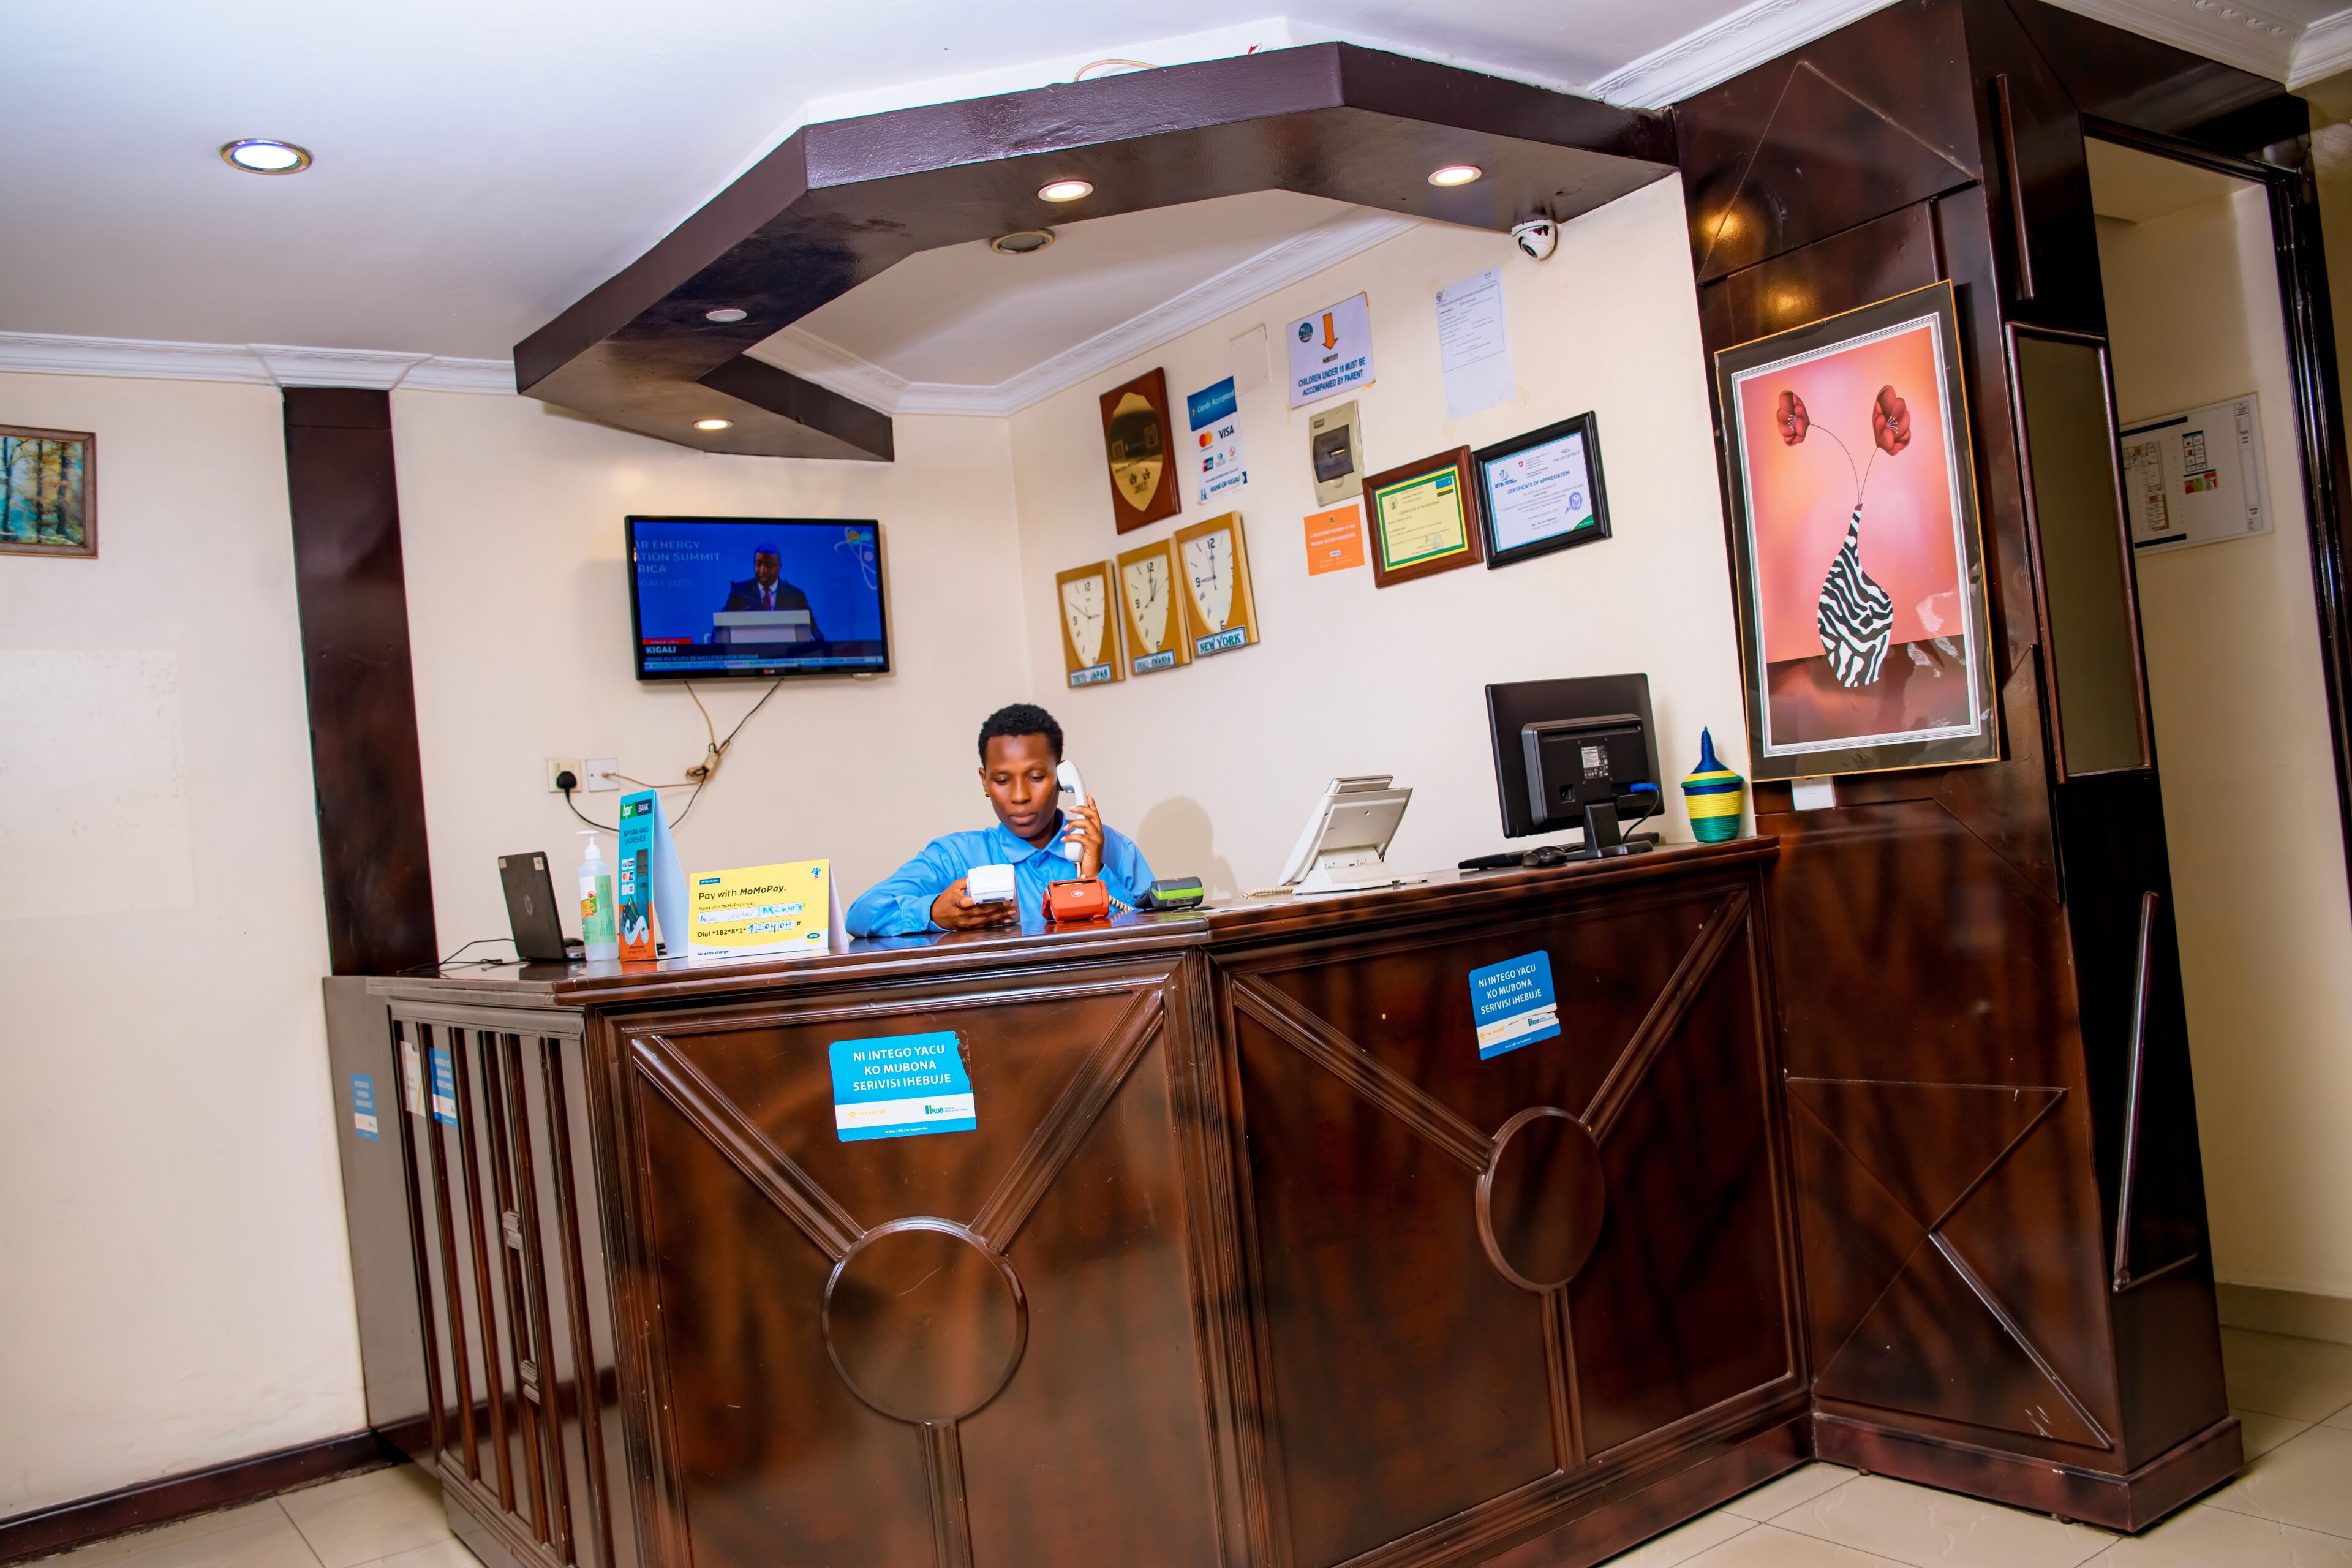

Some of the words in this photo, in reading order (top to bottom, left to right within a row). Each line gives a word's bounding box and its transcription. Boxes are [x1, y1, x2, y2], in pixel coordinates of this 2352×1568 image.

[1298, 373, 1321, 387] CHILDREN
[1322, 367, 1338, 379] UNDER
[1339, 364, 1344, 373] 18
[1345, 360, 1358, 371] MUST
[1359, 356, 1365, 366] BE
[1303, 379, 1336, 396] ACCOMPANIED
[1337, 376, 1344, 385] BY
[1344, 369, 1363, 383] PARENT
[1197, 402, 1211, 413] Cards
[1212, 389, 1234, 405] Accepted
[1218, 424, 1234, 439] VISA
[1210, 483, 1222, 492] BANK
[1507, 482, 1532, 494] CERTIFICATE
[1540, 470, 1570, 484] APPRECIATION
[653, 540, 700, 549] ENERGY
[1207, 538, 1216, 549] 12
[673, 552, 721, 561] SUMMIT
[1147, 562, 1154, 572] 12
[1084, 582, 1091, 592] 12
[1195, 577, 1201, 587] 9
[1135, 599, 1140, 609] 9
[1073, 616, 1078, 625] 9
[1200, 637, 1215, 655] NEW
[1216, 633, 1241, 650] YORK
[623, 805, 632, 819] bpr
[638, 803, 649, 813] BANK
[718, 889, 737, 898] with
[739, 885, 786, 896] MoMoPay.
[1479, 978, 1487, 988] NI
[1488, 970, 1516, 985] INTEGO
[1517, 963, 1536, 976] YACU
[1487, 989, 1498, 999] KO
[1499, 979, 1532, 995] MUBONA
[1481, 998, 1511, 1014] SERIVISI
[1512, 989, 1542, 1005] IHEBUJE
[853, 1052, 865, 1061] NI
[869, 1047, 912, 1060] INTEGO
[914, 1044, 945, 1056] YACU
[864, 1066, 881, 1076] KO
[883, 1060, 937, 1074] MUBONA
[853, 1079, 900, 1091] SERIVISI
[903, 1074, 951, 1087] IHEBUJE
